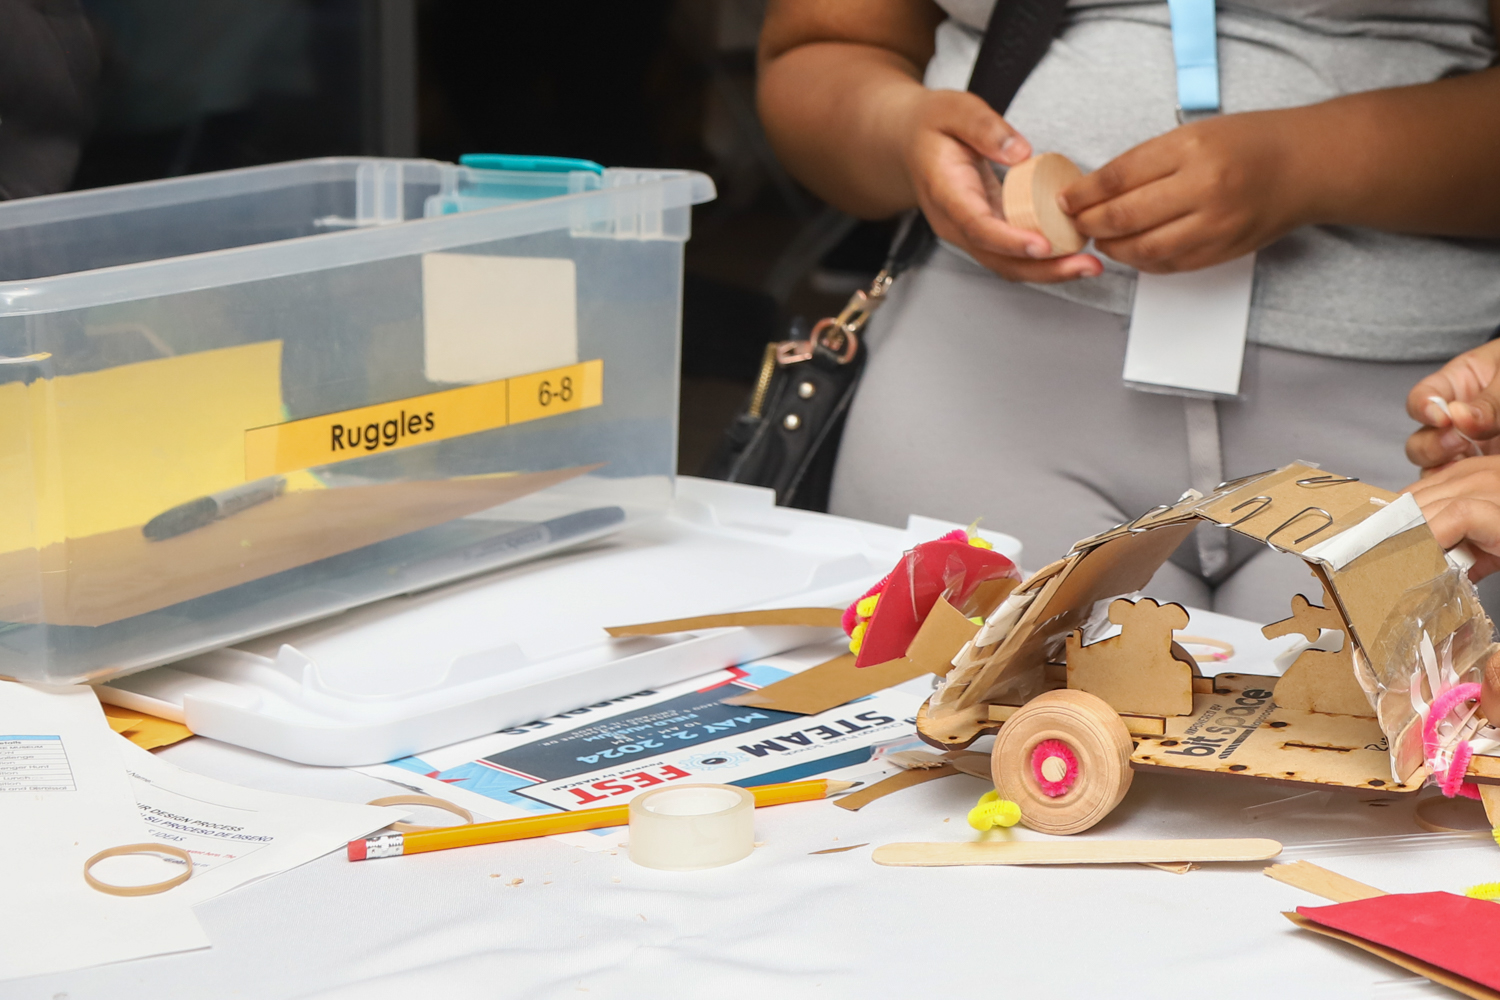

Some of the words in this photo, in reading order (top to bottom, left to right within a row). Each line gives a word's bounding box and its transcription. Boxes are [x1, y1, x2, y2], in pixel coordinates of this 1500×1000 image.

[331, 411, 435, 451] Ruggles
[539, 376, 573, 407] 6-8
[653, 713, 699, 728] FIELD
[658, 725, 680, 735] AM
[702, 712, 770, 734] MAY
[1164, 735, 1228, 758] bit
[1206, 689, 1274, 736] space
[663, 728, 699, 741] 2,
[739, 710, 897, 758] STEAM
[576, 737, 665, 765] 2024
[595, 771, 611, 781] by
[612, 760, 662, 777] Powered
[550, 776, 594, 792] NASCAR
[568, 764, 692, 805] FEST
[150, 808, 192, 823] DESIGN
[192, 819, 245, 832] PROCESS
[161, 820, 216, 836] PROCESO
